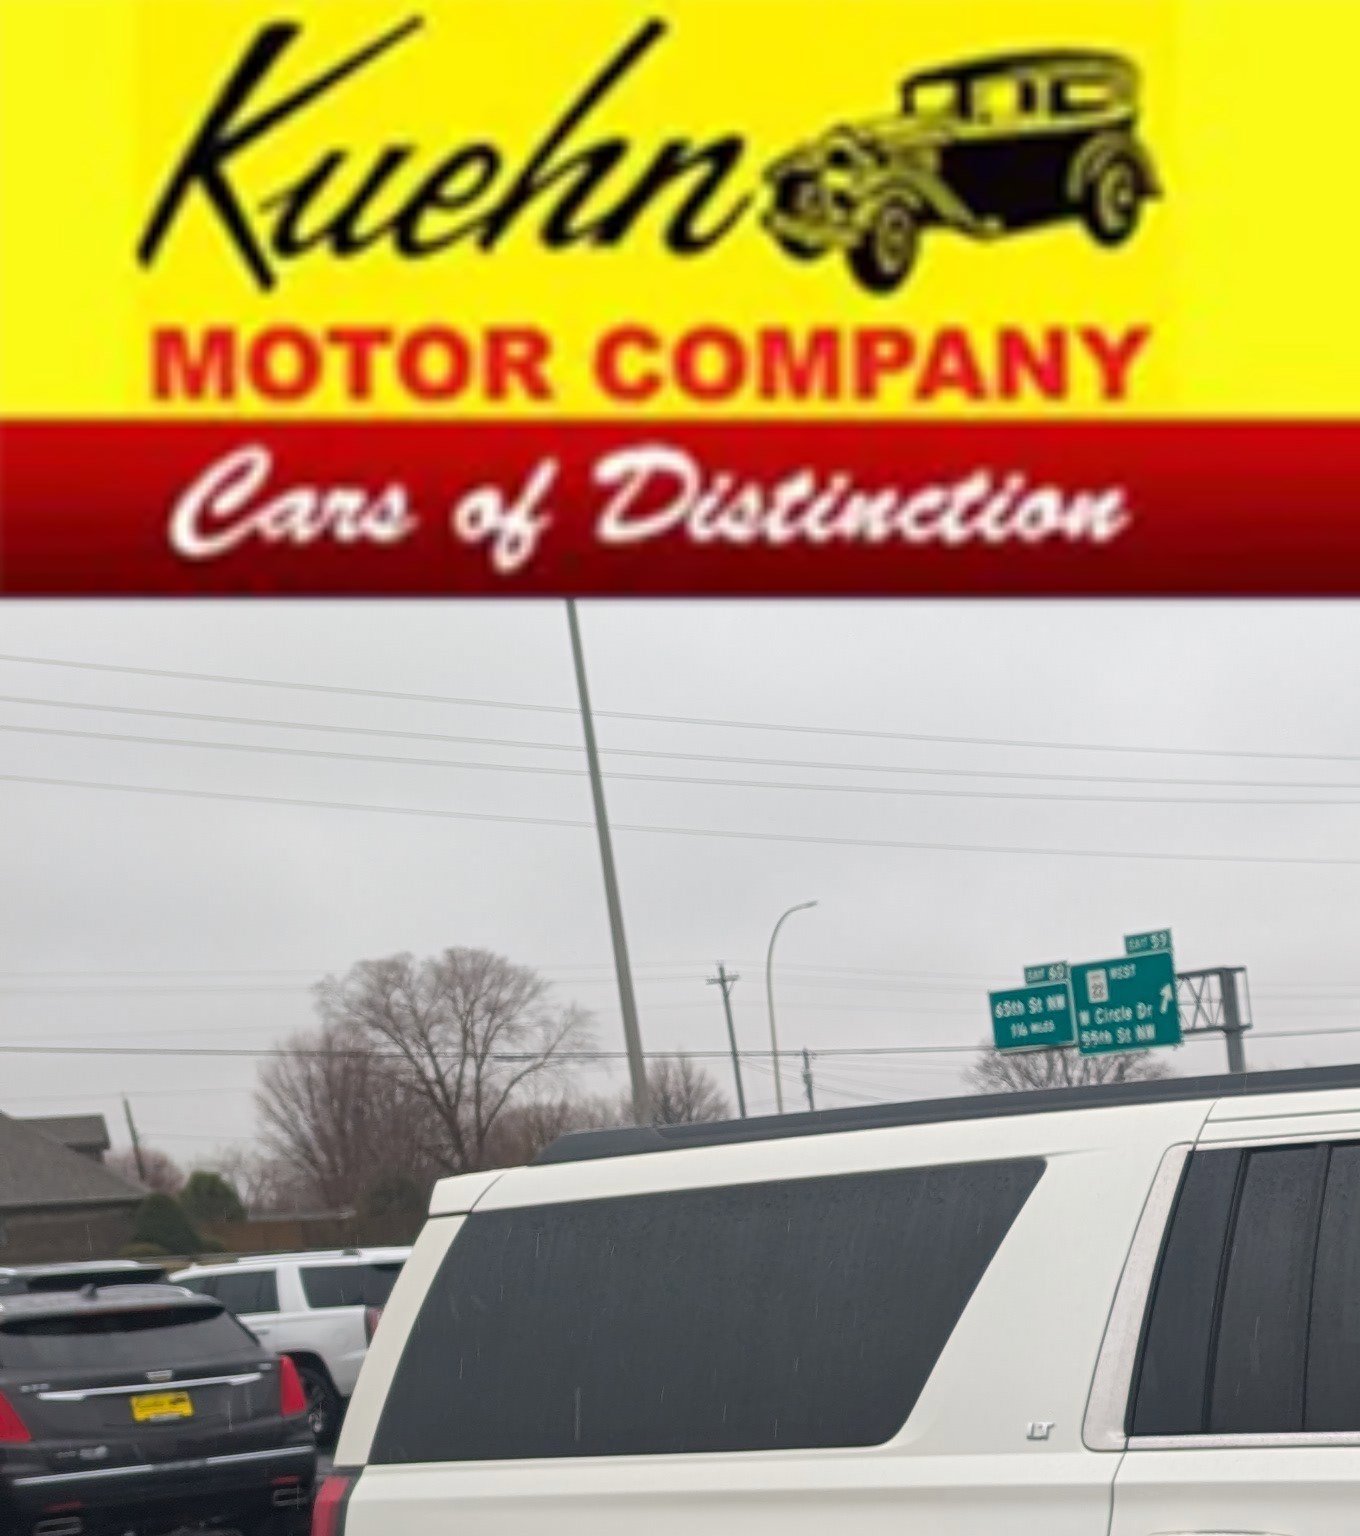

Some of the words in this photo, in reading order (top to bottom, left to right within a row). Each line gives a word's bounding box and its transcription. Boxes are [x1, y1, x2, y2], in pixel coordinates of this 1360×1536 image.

[1028, 997, 1042, 1014] St
[1094, 1006, 1133, 1025] Circle
[1136, 1002, 1152, 1020] Dr
[1116, 1027, 1131, 1044] St
